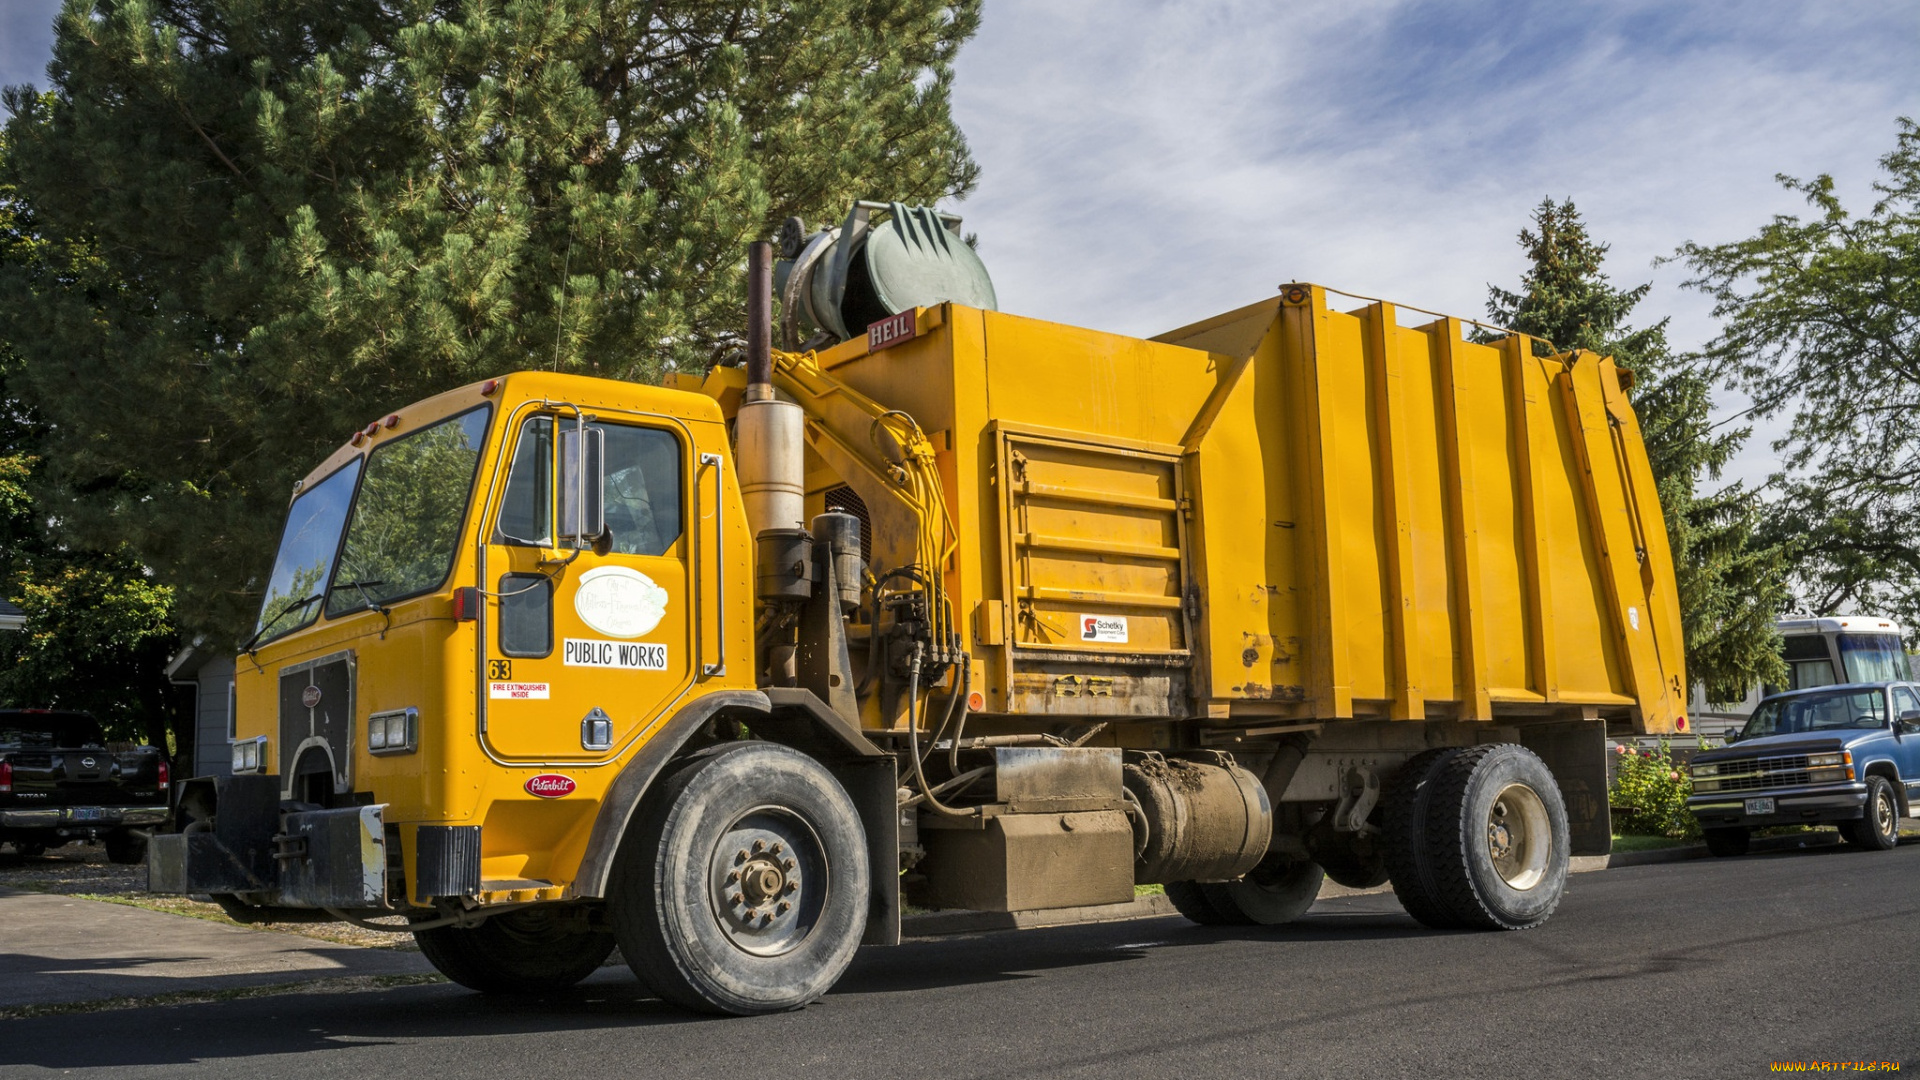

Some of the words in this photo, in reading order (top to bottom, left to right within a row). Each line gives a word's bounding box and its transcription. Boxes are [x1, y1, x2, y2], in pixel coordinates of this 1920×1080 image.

[871, 316, 909, 346] HEIL
[1097, 620, 1123, 631] Schetky
[566, 641, 612, 665] PUBLIC
[619, 644, 665, 668] WORKS
[489, 661, 511, 679] 63
[531, 778, 570, 791] Peterbilt
